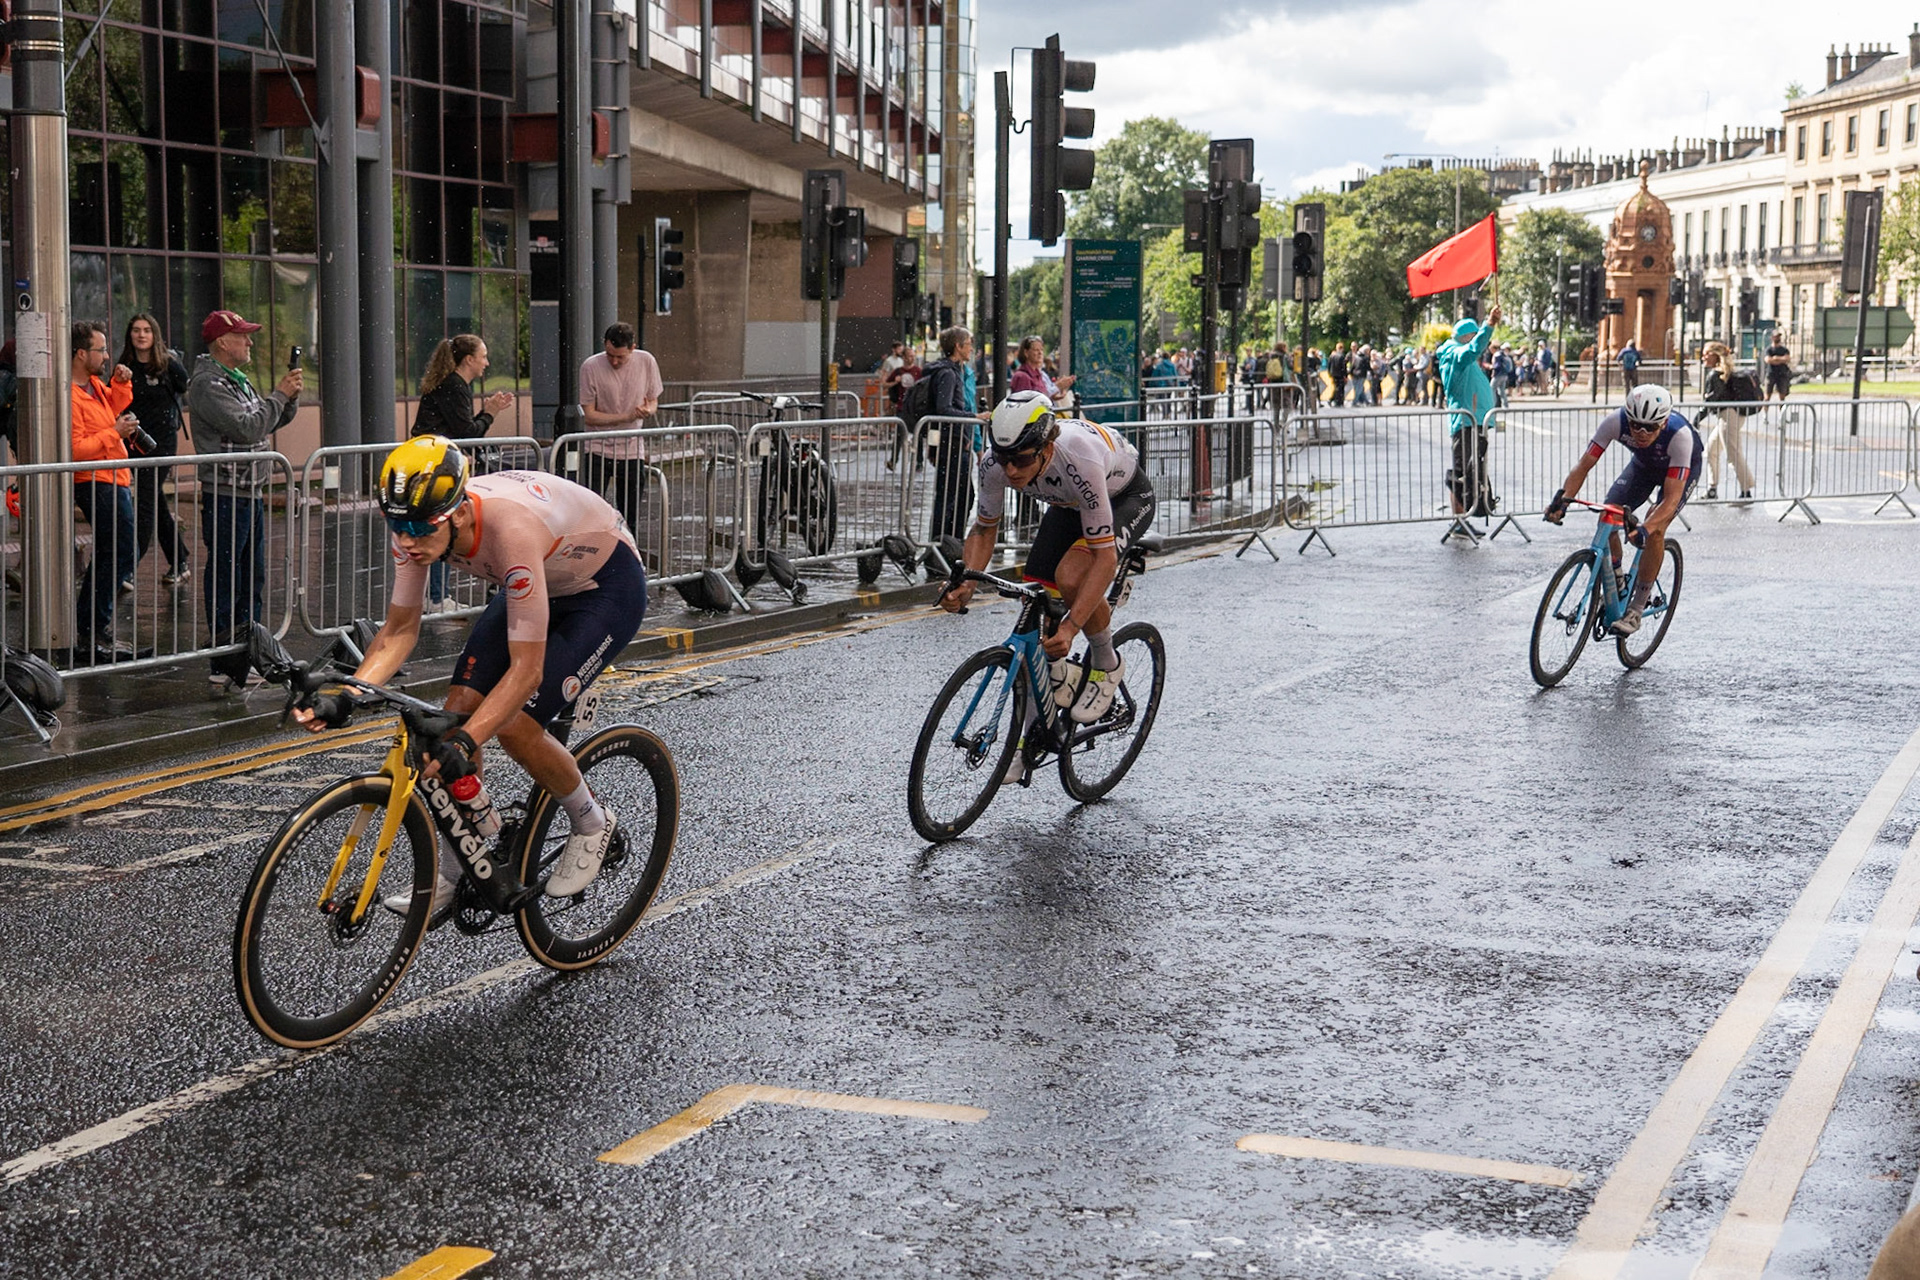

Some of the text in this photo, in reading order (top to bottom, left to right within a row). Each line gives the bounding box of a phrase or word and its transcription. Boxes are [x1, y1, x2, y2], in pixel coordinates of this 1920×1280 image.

[1066, 463, 1100, 510] Cofidis
[1129, 503, 1152, 531] Movistar
[576, 634, 614, 679] NEDERLANDSE
[582, 697, 597, 723] 55
[590, 740, 631, 762] RESERVE
[421, 777, 493, 880] cervélo
[577, 935, 615, 960] RESERVE
[371, 947, 411, 1001] RESERVE
